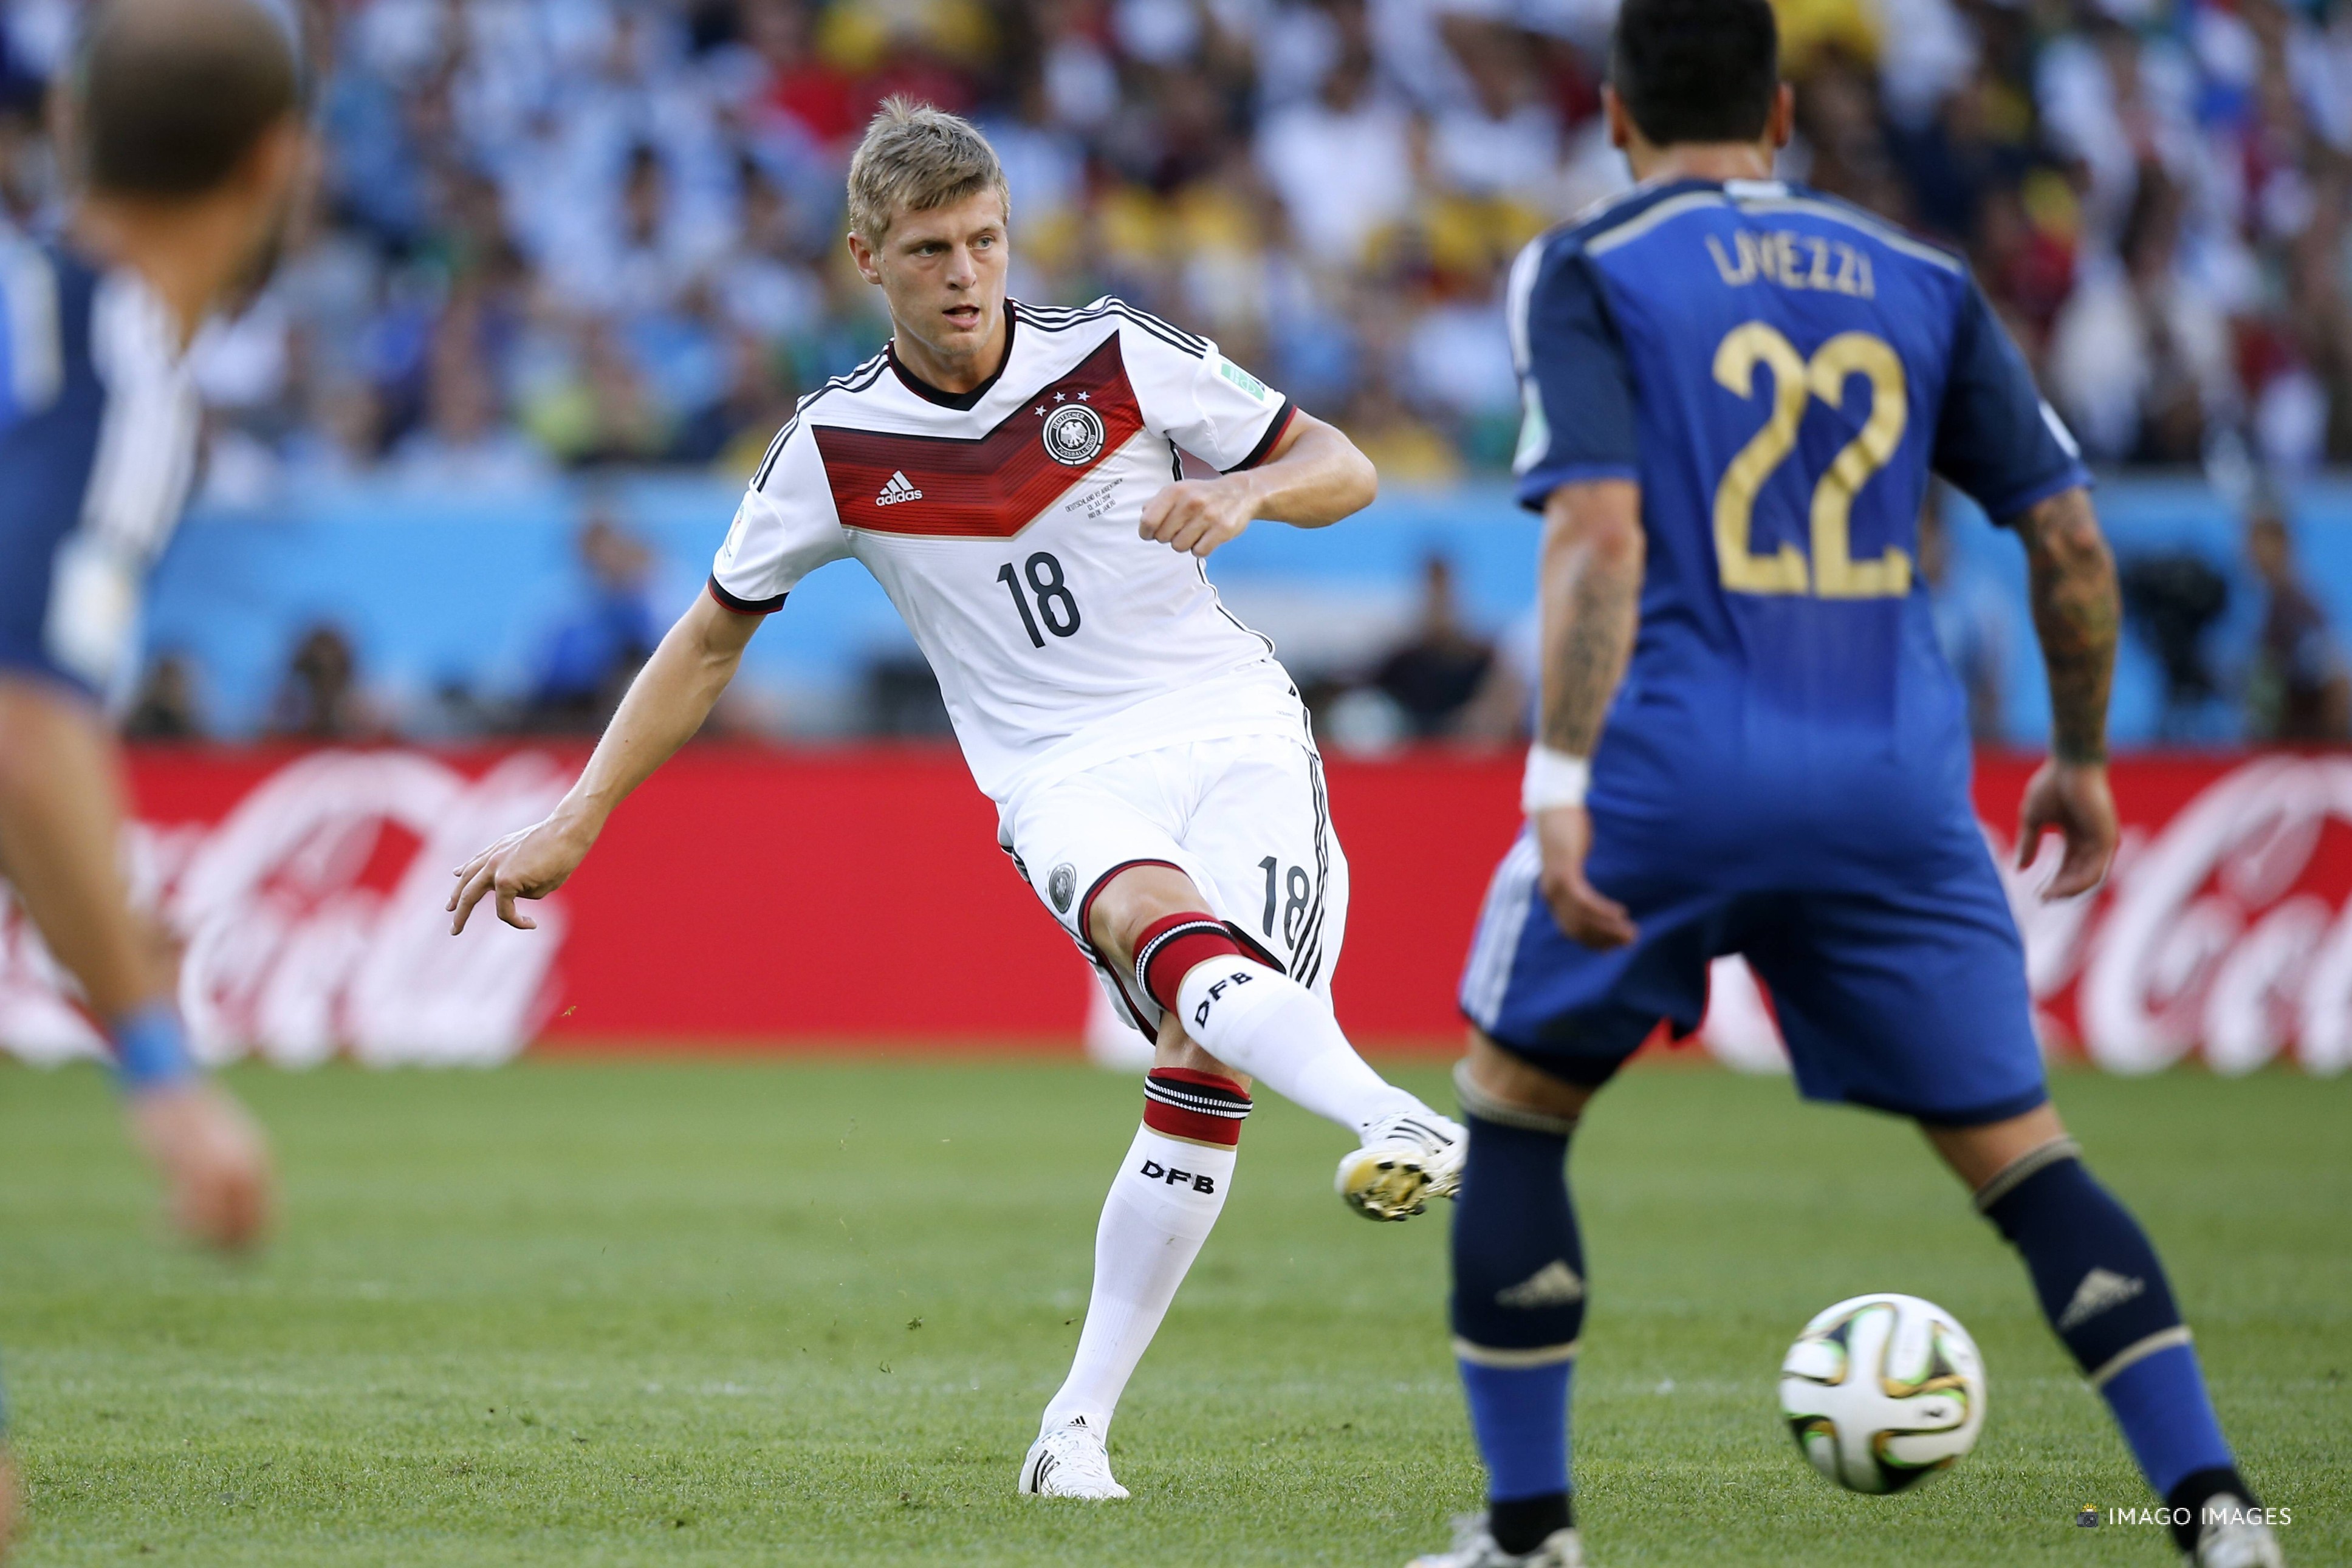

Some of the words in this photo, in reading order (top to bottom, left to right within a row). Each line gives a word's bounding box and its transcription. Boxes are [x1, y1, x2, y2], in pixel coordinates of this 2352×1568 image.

[1052, 412, 1085, 430] DEUTSCHER
[1712, 320, 1913, 599] 22
[876, 489, 923, 507] adidas
[996, 552, 1081, 649] 18
[1258, 855, 1310, 951] 18
[1195, 972, 1253, 1030] DFB
[1140, 1159, 1215, 1194] DFB
